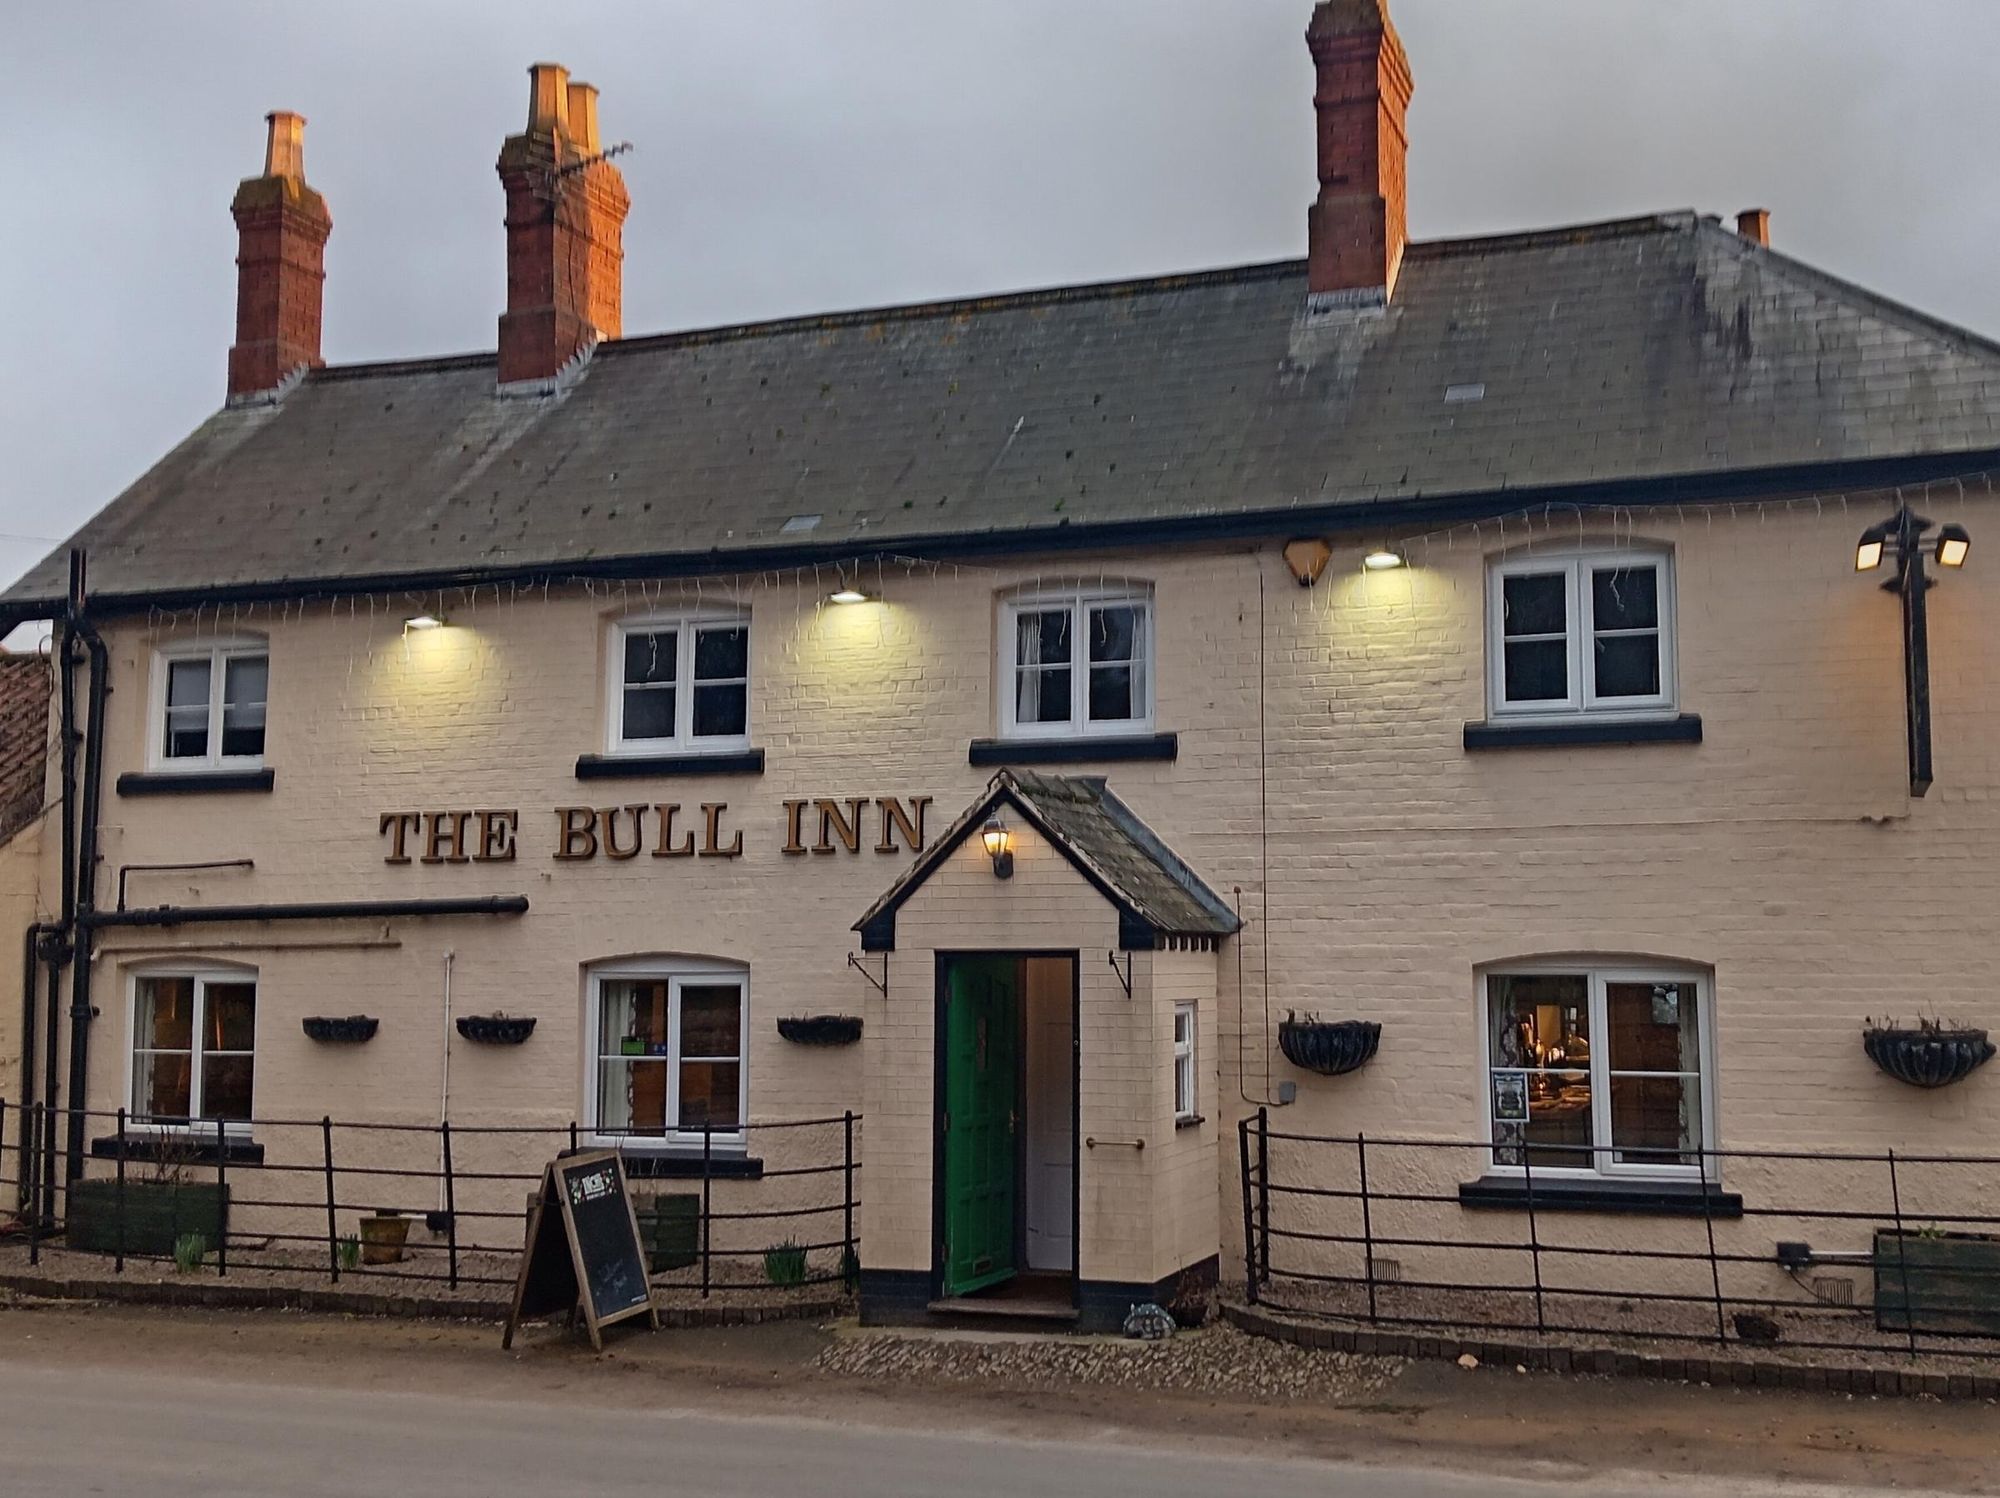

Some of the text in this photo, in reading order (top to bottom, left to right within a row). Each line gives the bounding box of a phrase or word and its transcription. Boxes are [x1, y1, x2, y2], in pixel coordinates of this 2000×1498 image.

[380, 796, 933, 863] THE BULL INN
